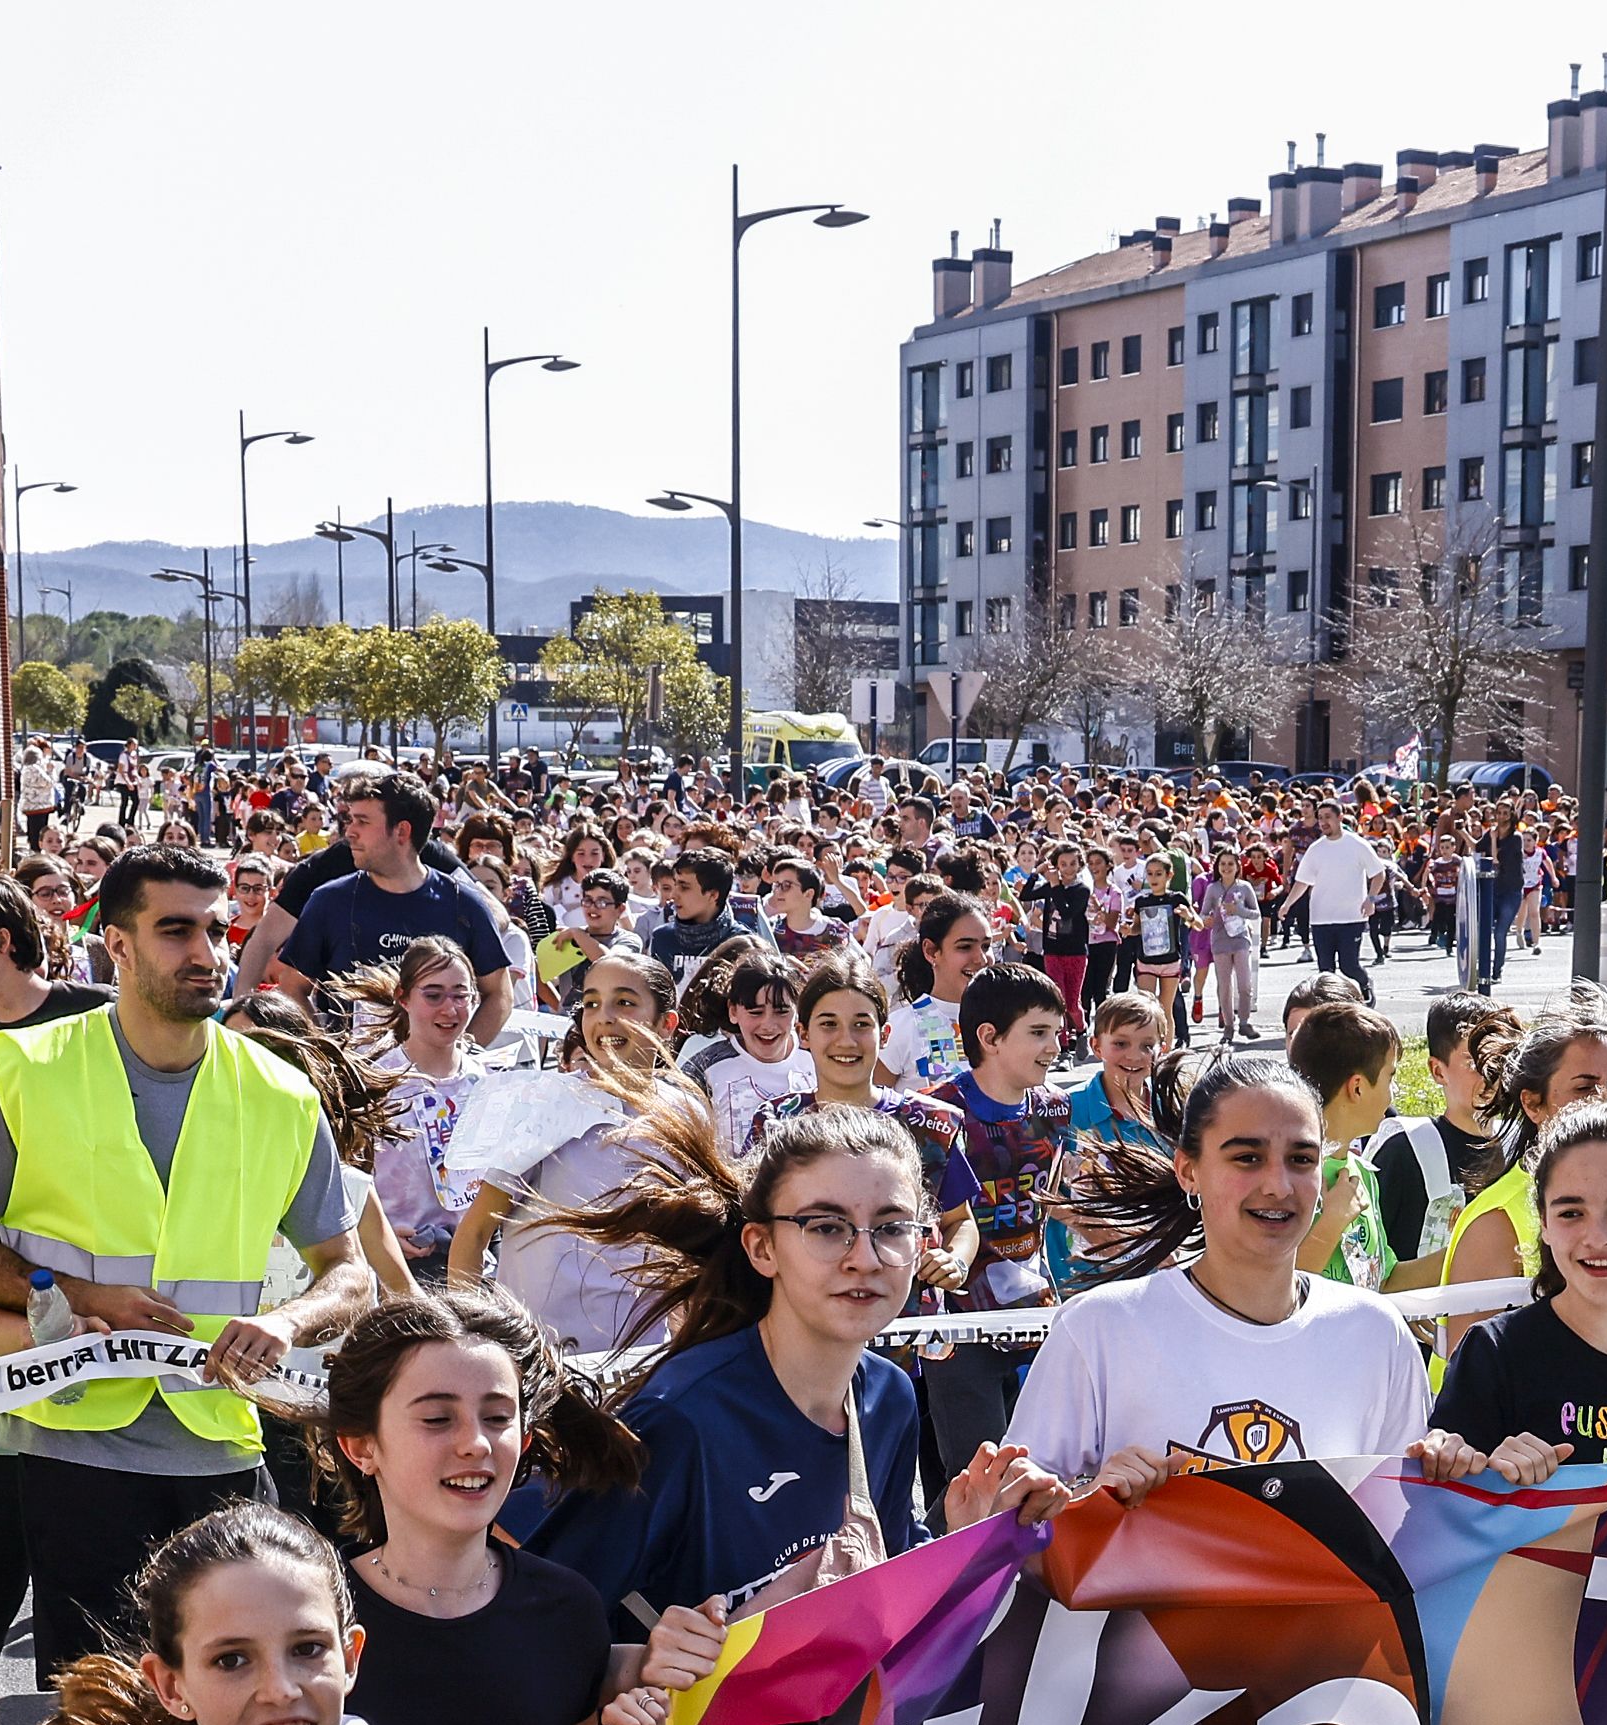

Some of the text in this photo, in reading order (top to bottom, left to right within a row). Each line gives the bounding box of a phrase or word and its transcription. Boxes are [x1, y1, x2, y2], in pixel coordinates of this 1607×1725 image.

[1048, 1104, 1070, 1118] eitb
[926, 1117, 952, 1135] eitb
[7, 1347, 95, 1392] berria
[1216, 1403, 1251, 1415] CAMPEONATO
[1250, 1430, 1263, 1447] 100
[774, 1542, 800, 1568] CLUB
[802, 1536, 817, 1549] DE
